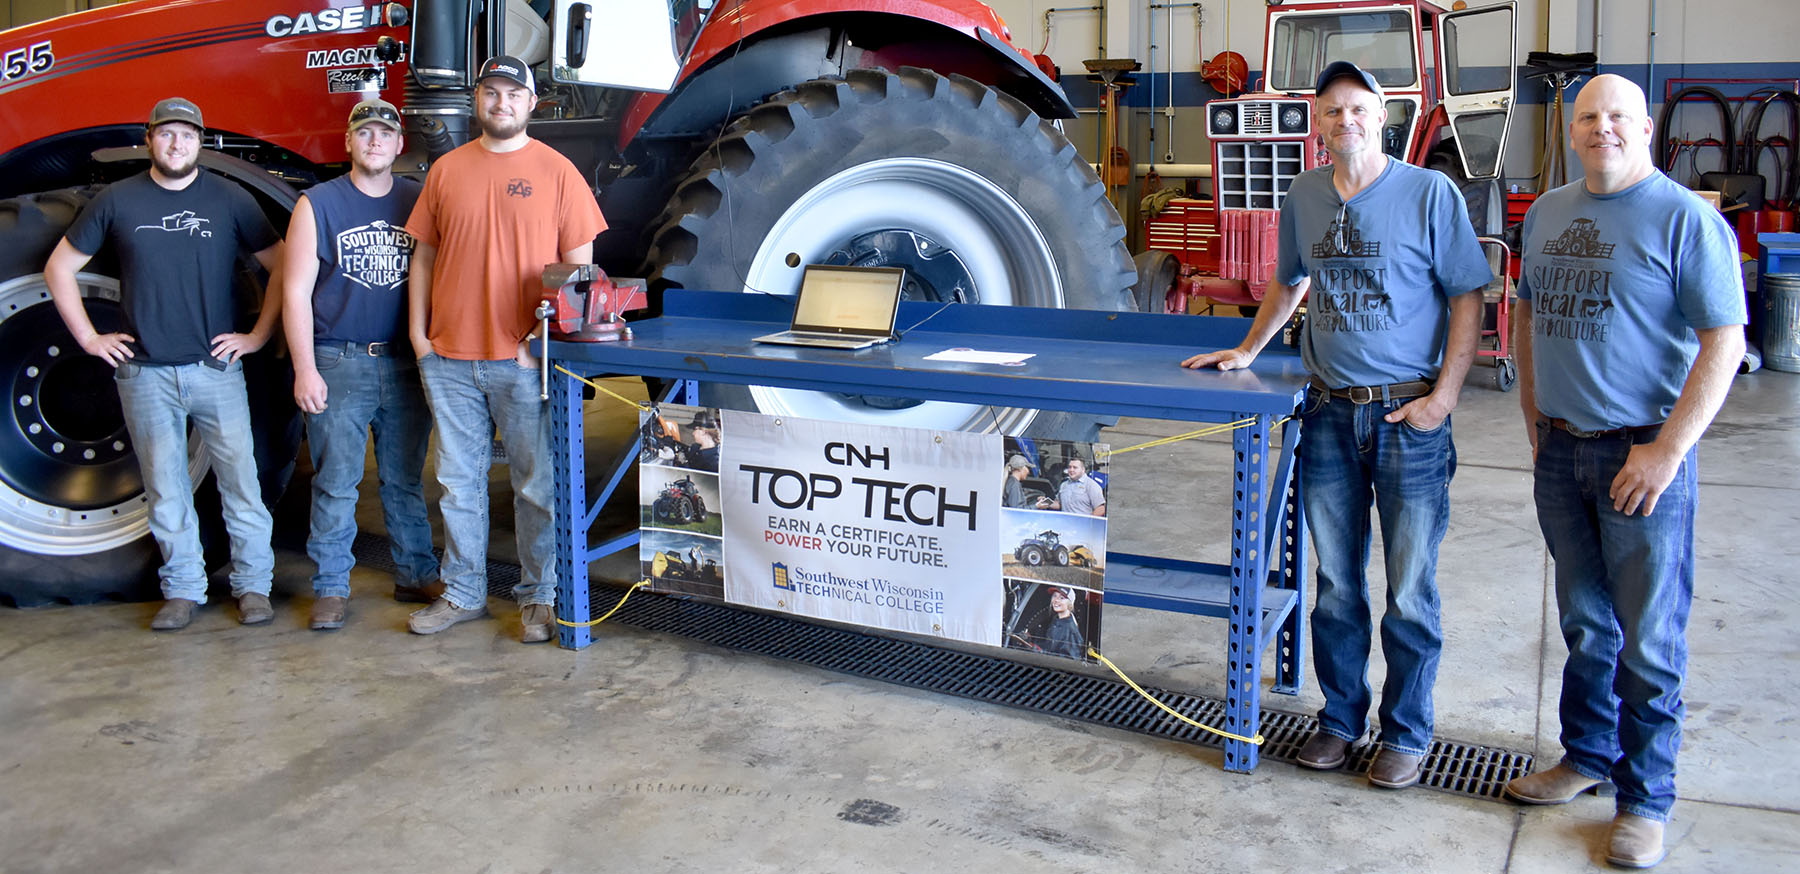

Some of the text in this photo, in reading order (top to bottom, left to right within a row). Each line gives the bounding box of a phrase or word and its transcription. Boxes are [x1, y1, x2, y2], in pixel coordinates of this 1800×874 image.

[265, 6, 365, 38] CASE
[0, 40, 55, 83] 55
[306, 42, 405, 69] MAGN
[342, 231, 414, 250] SOUTHWEST
[364, 245, 398, 255] WISCONSIN
[343, 255, 411, 273] TECHNICA
[360, 270, 401, 286] COLLEGE
[1312, 268, 1386, 291] SUPPORT
[1533, 266, 1613, 296] SUPPORT
[824, 442, 890, 470] CNH
[739, 464, 978, 531] TOP TECH
[768, 516, 943, 551] EARN A CERTIFICATE.
[764, 530, 948, 568] POWER YOUR FUTURE.
[795, 566, 944, 601] Southwest Wisconsin
[796, 582, 944, 614] TECHNICAL COLLEGE
